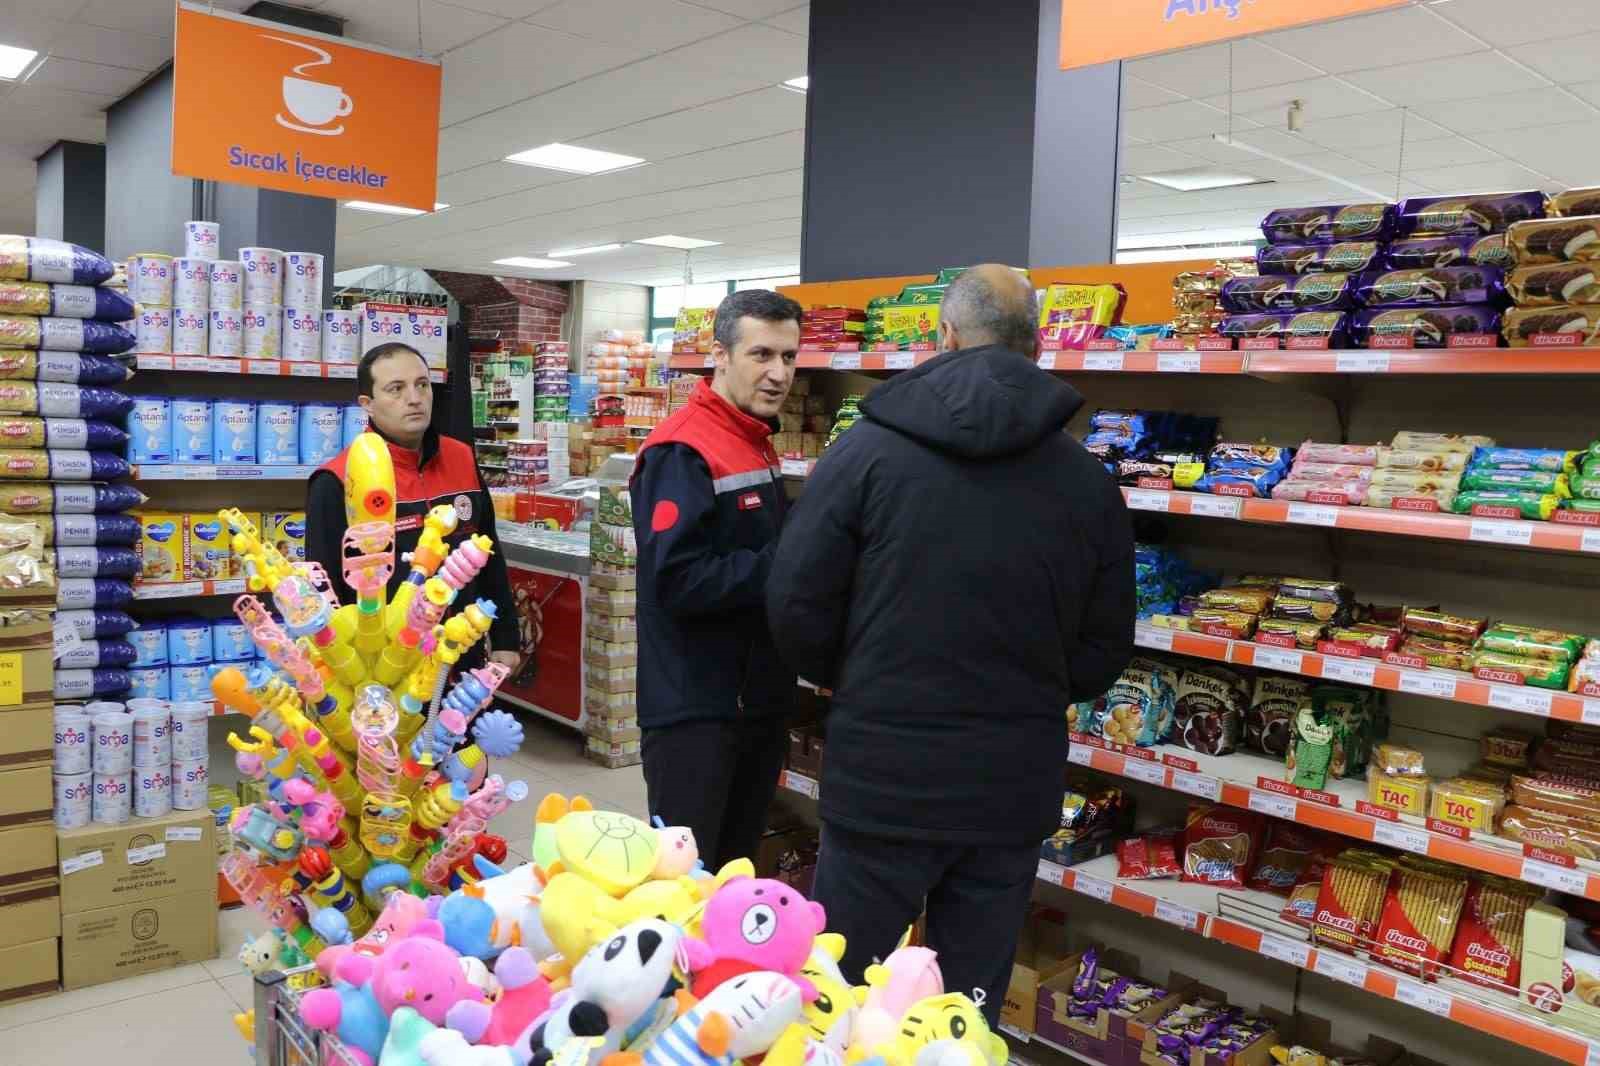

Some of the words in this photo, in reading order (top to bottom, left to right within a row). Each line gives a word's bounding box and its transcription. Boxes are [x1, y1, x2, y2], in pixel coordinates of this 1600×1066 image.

[229, 146, 288, 173] Sıcak
[295, 152, 388, 188] İçecekler
[141, 262, 167, 279] sma
[248, 256, 276, 274] sma
[213, 268, 237, 283] sma
[144, 312, 168, 329] sma
[179, 314, 203, 330] sma
[293, 314, 319, 334] sma
[331, 318, 359, 336] sma
[371, 317, 401, 336] sma
[412, 319, 442, 338] sma
[134, 413, 168, 425] Aptamil
[221, 415, 254, 426] Aptamil
[64, 527, 91, 537] PENNE
[1387, 655, 1421, 668] ÜLKER
[1479, 668, 1518, 682] ÜLKER
[55, 727, 85, 746] sma
[100, 730, 129, 747] sma
[97, 779, 127, 797] sma
[144, 773, 170, 790] sma
[1318, 912, 1355, 933] ÜLKER
[1386, 929, 1427, 951] ÜLKER
[1467, 943, 1510, 966] ÜLKER
